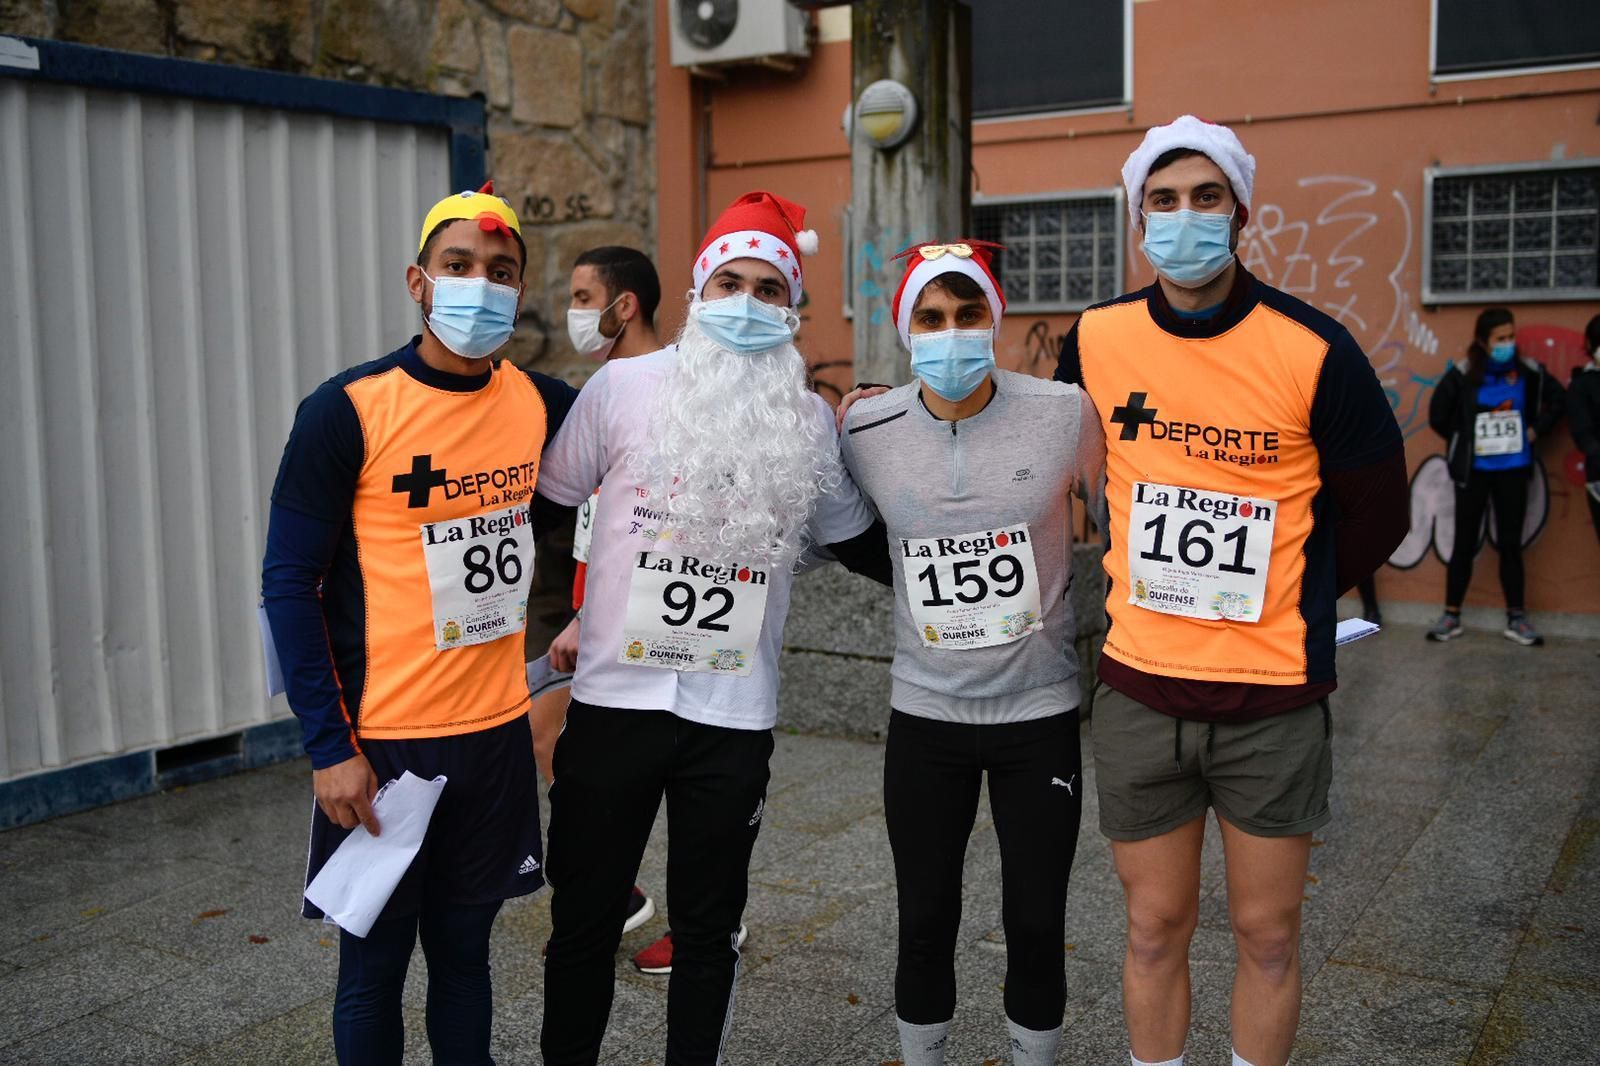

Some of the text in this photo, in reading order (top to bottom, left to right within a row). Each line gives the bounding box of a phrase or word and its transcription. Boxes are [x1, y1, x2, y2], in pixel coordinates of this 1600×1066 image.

[522, 194, 555, 218] NO
[1150, 420, 1280, 451] DEPORTE
[1479, 421, 1518, 439] 118
[1184, 444, 1278, 467] La Región
[479, 494, 499, 507] La
[1135, 483, 1272, 522] La Región
[423, 523, 465, 546] La
[902, 530, 1027, 558] La Región
[1139, 513, 1257, 576] 161
[462, 537, 523, 594] 86
[637, 551, 767, 585] La Región
[918, 554, 1025, 607] 159
[661, 581, 735, 633] 92
[1149, 591, 1196, 606] OURENSE
[466, 617, 507, 633] OURENSE
[942, 628, 986, 640] OURENSE
[650, 650, 696, 662] OURENSE
